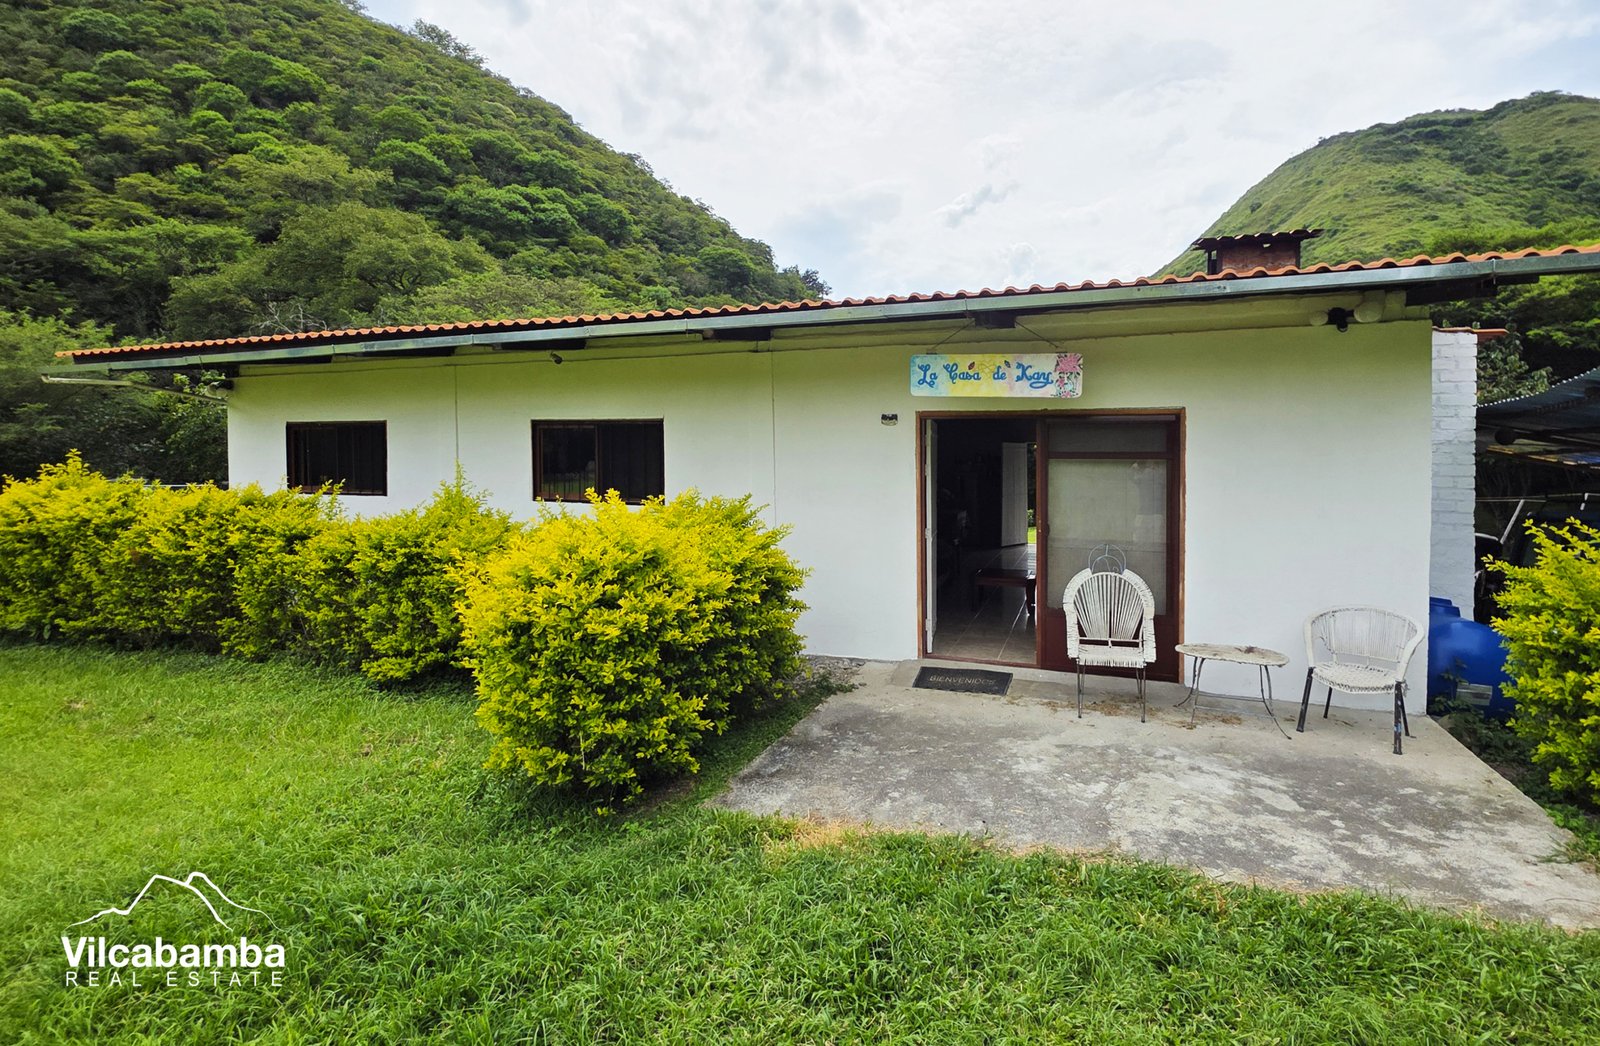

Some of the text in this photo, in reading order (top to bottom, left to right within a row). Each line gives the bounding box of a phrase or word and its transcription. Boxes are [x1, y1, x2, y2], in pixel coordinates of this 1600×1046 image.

[918, 362, 1054, 389] La Casa de Kay
[929, 675, 996, 685] BIENVENIDOS
